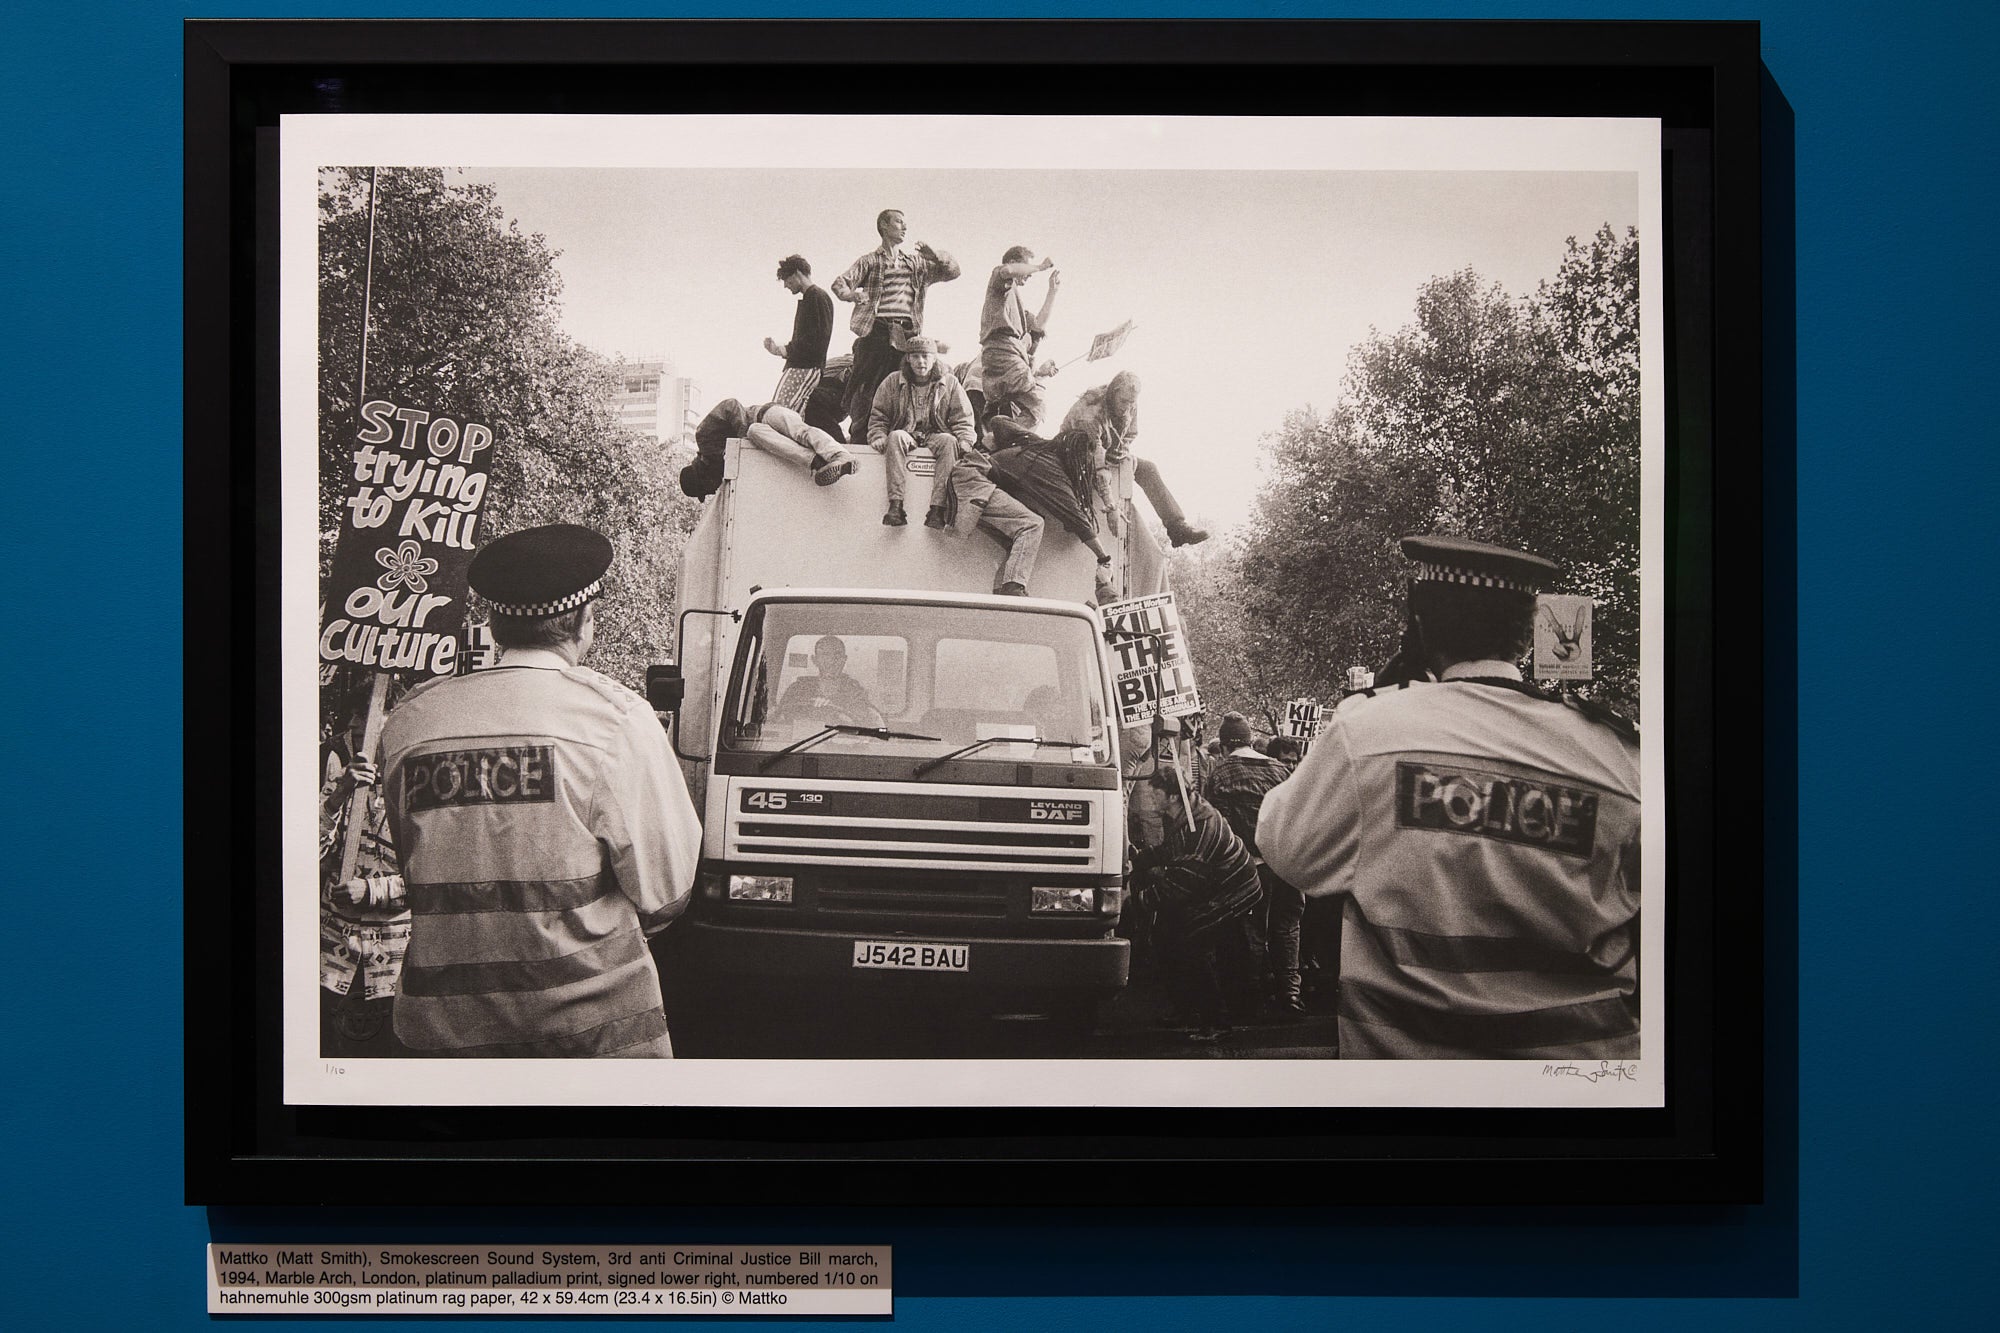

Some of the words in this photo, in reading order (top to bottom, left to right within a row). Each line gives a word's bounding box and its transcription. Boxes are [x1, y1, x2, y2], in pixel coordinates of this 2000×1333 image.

[356, 400, 493, 464] STOP
[353, 444, 488, 513] trying
[346, 487, 392, 529] to
[345, 587, 453, 628] our
[1107, 601, 1143, 616] Socialist
[1143, 597, 1169, 608] Worker
[1104, 607, 1178, 645] KILL
[456, 652, 485, 675] HE
[1113, 633, 1179, 671] THE
[1117, 664, 1159, 681] CRIMINAL
[1160, 657, 1186, 670] USTICE
[1117, 667, 1193, 708] BILL
[1125, 712, 1140, 723] THE
[1140, 709, 1156, 720] REA
[1133, 702, 1147, 713] THE
[1147, 696, 1173, 711] TOIES
[399, 752, 544, 816] POLICE
[748, 791, 788, 810] 45
[799, 793, 823, 803] 130
[1030, 801, 1083, 810] LEYLAND
[1412, 772, 1582, 846] POLICE
[1030, 808, 1083, 820] DAF
[856, 944, 917, 967] J542
[921, 947, 967, 969] BAU
[220, 1251, 268, 1265] Mattko
[276, 1251, 313, 1268] (Matt
[321, 1251, 372, 1268] Smith),
[380, 1252, 479, 1265] Smokescreen
[487, 1252, 534, 1266] Sound
[542, 1252, 600, 1267] System,
[608, 1252, 632, 1266] 3rd
[640, 1252, 665, 1266] anti
[673, 1252, 733, 1266] Criminal
[740, 1252, 791, 1266] Justice
[800, 1252, 821, 1266] Bill
[829, 1252, 878, 1268] march,
[220, 1271, 260, 1287] 1994,
[265, 1271, 315, 1285] Marble
[319, 1271, 356, 1287] Arch,
[362, 1271, 420, 1287] London,
[426, 1271, 487, 1288] platinum
[492, 1271, 561, 1288] palladium
[566, 1272, 602, 1288] print,
[607, 1272, 656, 1288] signed
[660, 1272, 700, 1286] lower
[704, 1272, 740, 1288] right,
[745, 1272, 819, 1286] numbered
[824, 1272, 855, 1286] 1/10
[860, 1275, 878, 1286] on
[220, 1290, 309, 1304] hahnemuhle
[314, 1291, 371, 1308] 300gsm
[376, 1291, 437, 1308] platinum
[442, 1294, 466, 1308] rag
[470, 1294, 515, 1308] paper,
[520, 1292, 538, 1305] 42
[543, 1294, 552, 1305] x
[555, 1291, 609, 1305] 59.4cm
[614, 1291, 650, 1308] (23.4
[655, 1294, 664, 1305] x
[668, 1291, 717, 1308] 16.5in)
[721, 1291, 735, 1305] ©
[739, 1291, 787, 1305] Mattko
